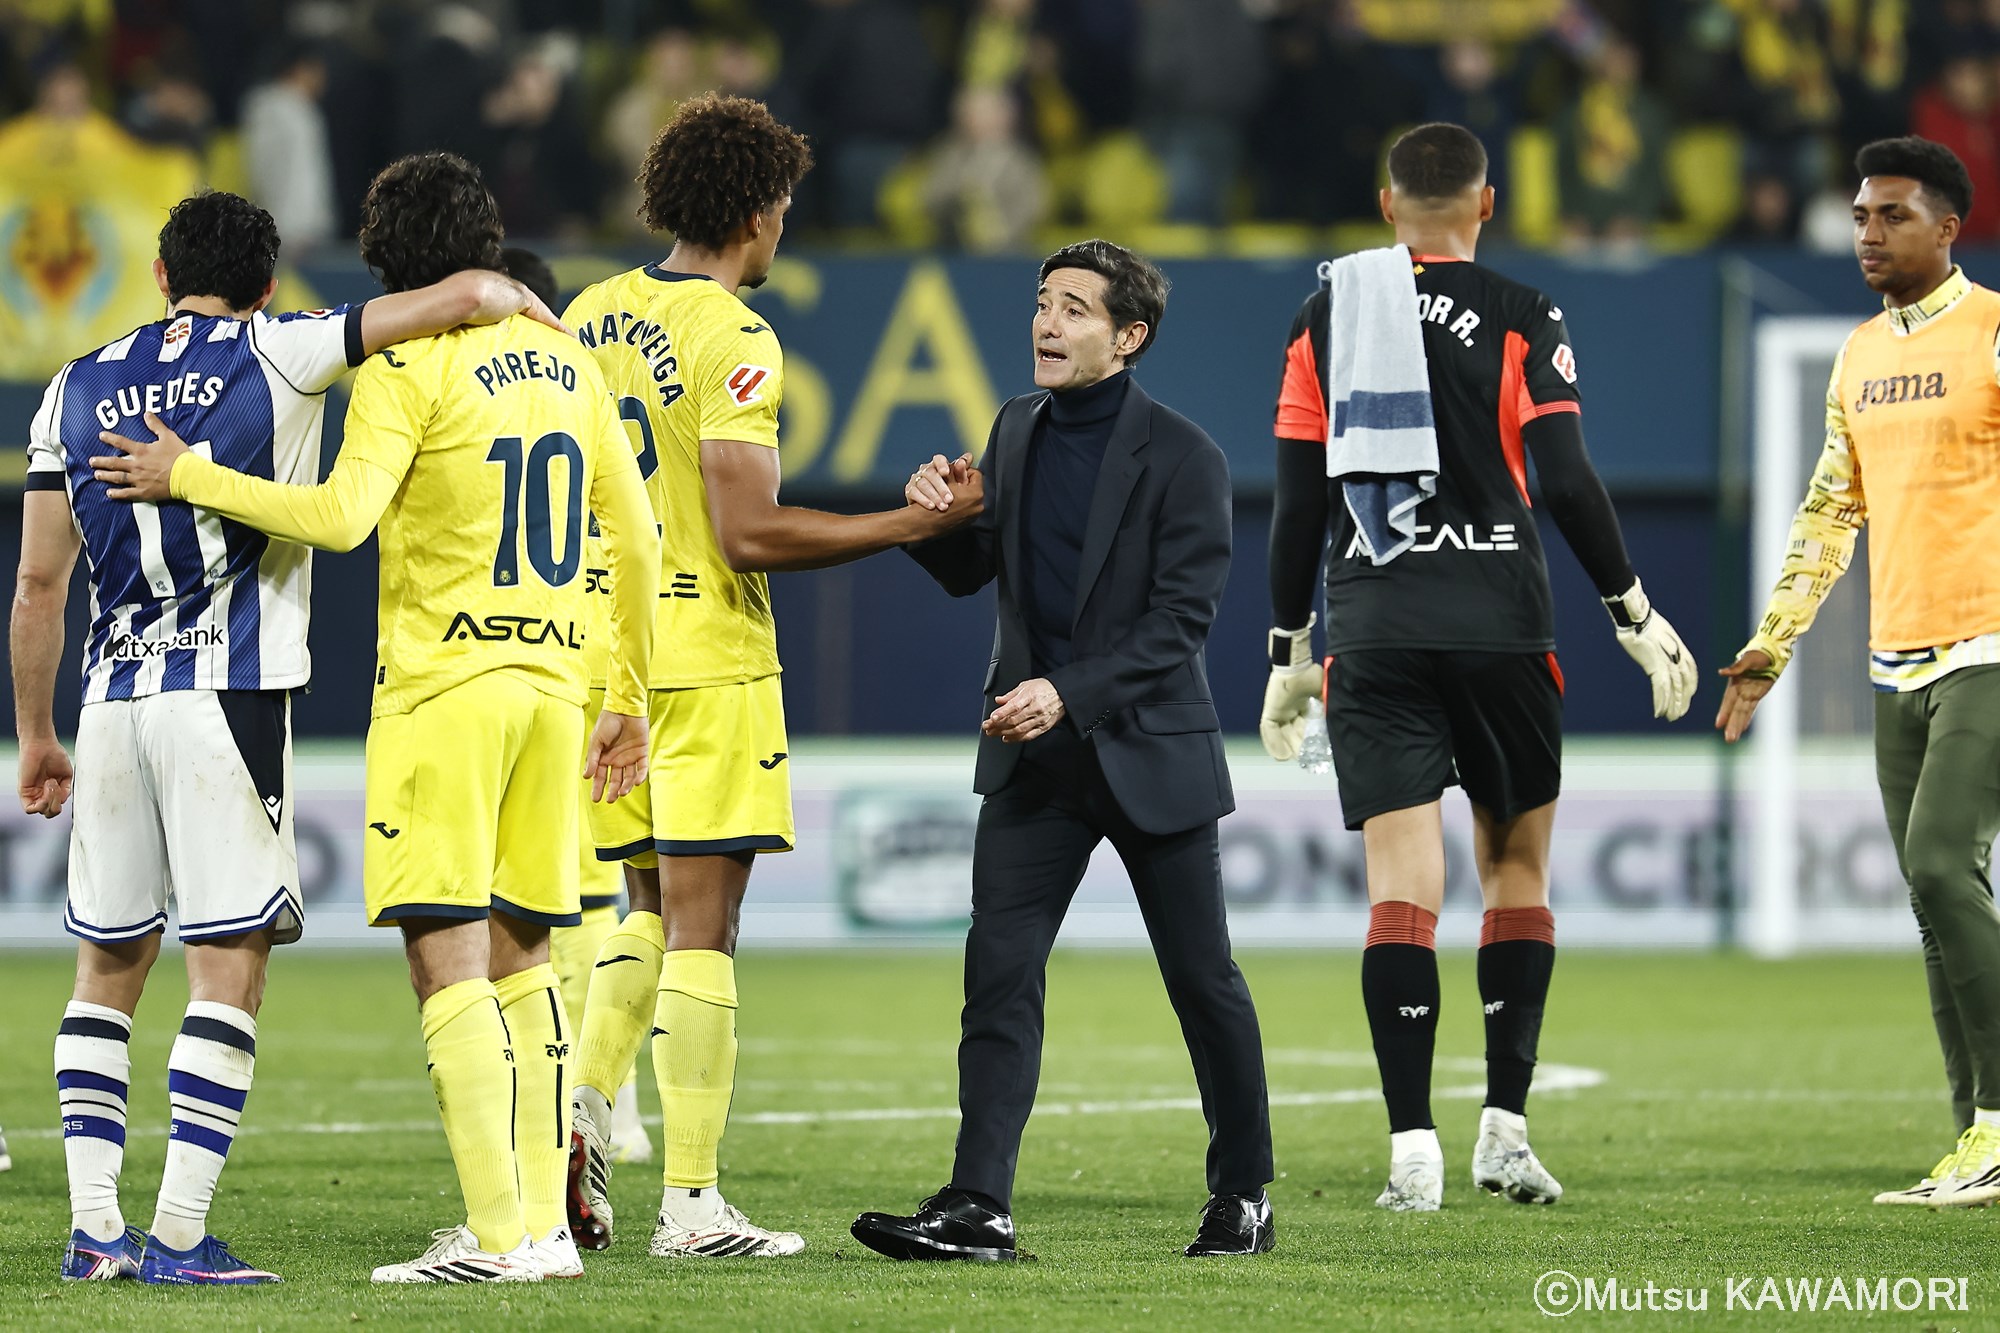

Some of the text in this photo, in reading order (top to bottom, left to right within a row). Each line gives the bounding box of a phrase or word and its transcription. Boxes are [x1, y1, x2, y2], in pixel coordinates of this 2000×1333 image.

[578, 311, 646, 350] NATO
[1417, 292, 1481, 348] OR R.
[474, 350, 576, 396] PAREJO
[95, 371, 224, 430] GUEDES
[485, 431, 584, 588] 10
[441, 611, 586, 650] ASCAL
